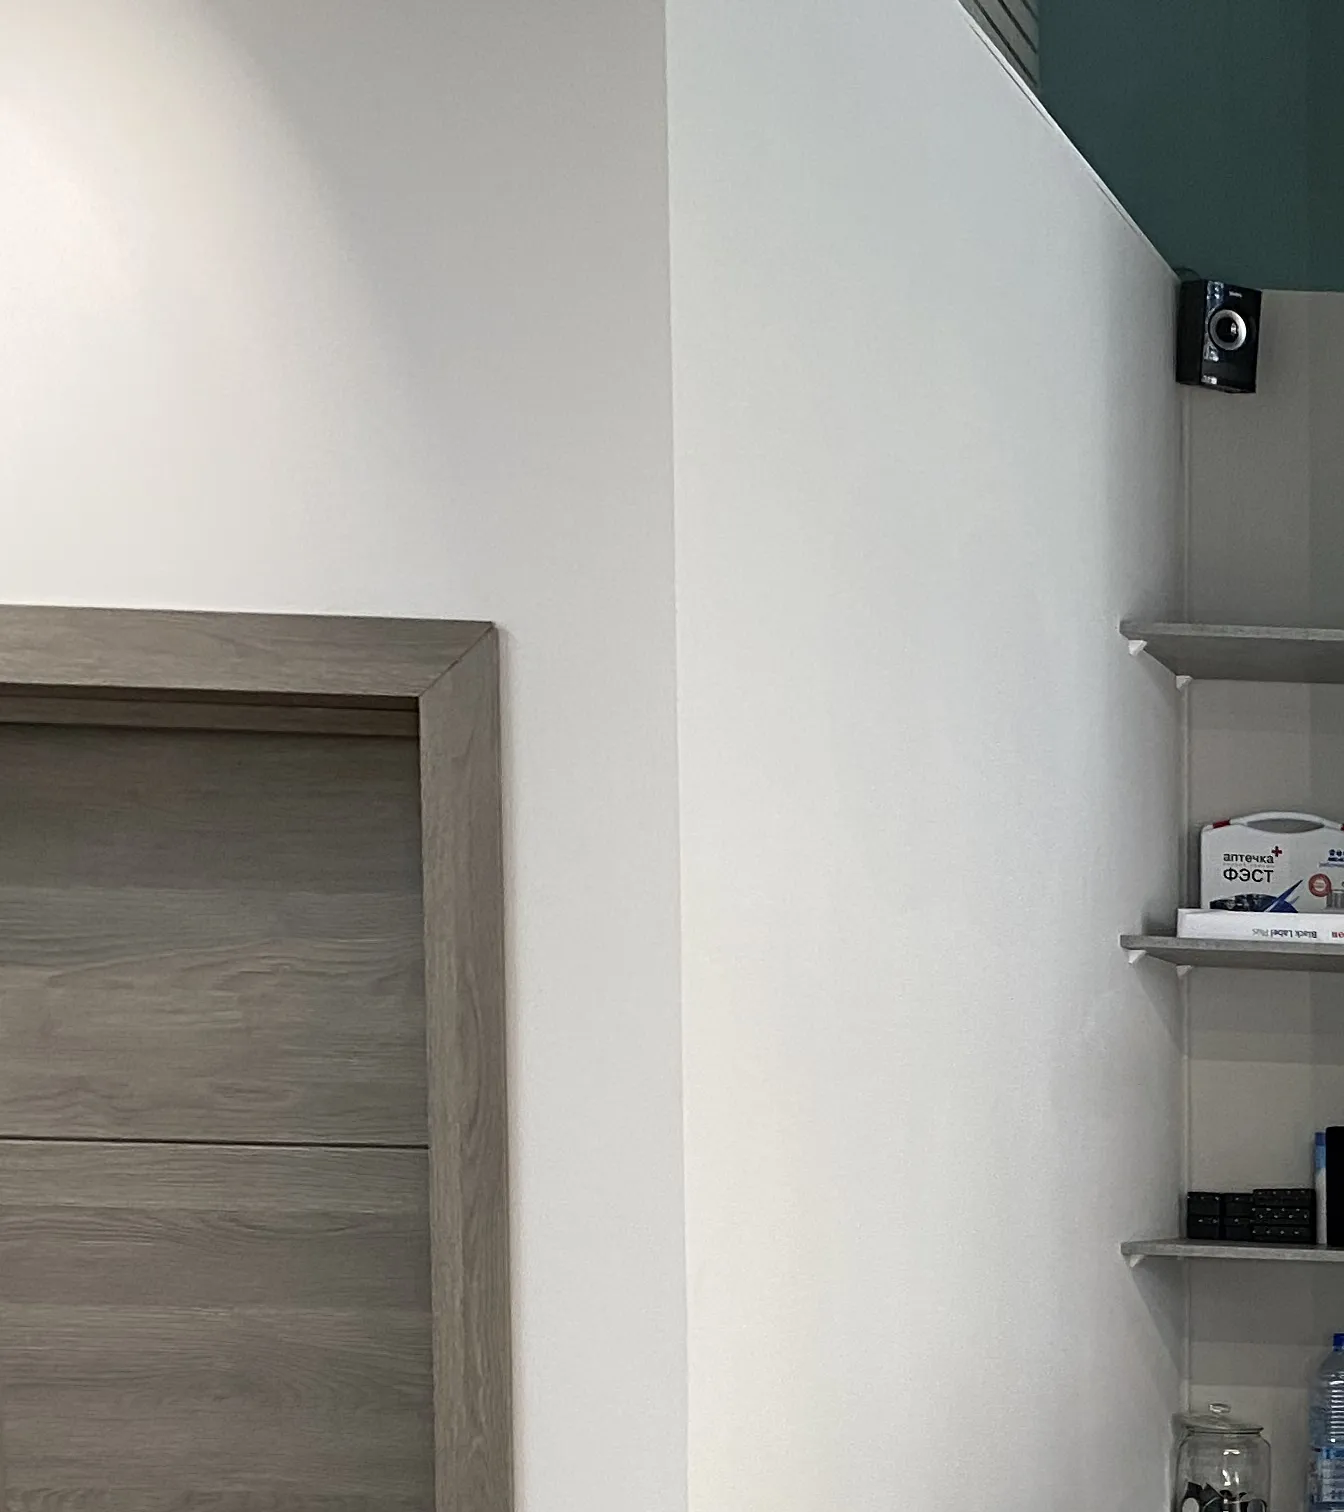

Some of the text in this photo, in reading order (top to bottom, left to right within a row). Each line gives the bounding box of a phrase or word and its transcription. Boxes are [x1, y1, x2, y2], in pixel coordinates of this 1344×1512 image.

[1223, 853, 1275, 864] аптечка
[1222, 867, 1275, 883] ФЭСТ
[1270, 928, 1293, 938] Label
[1295, 929, 1318, 939] Black
